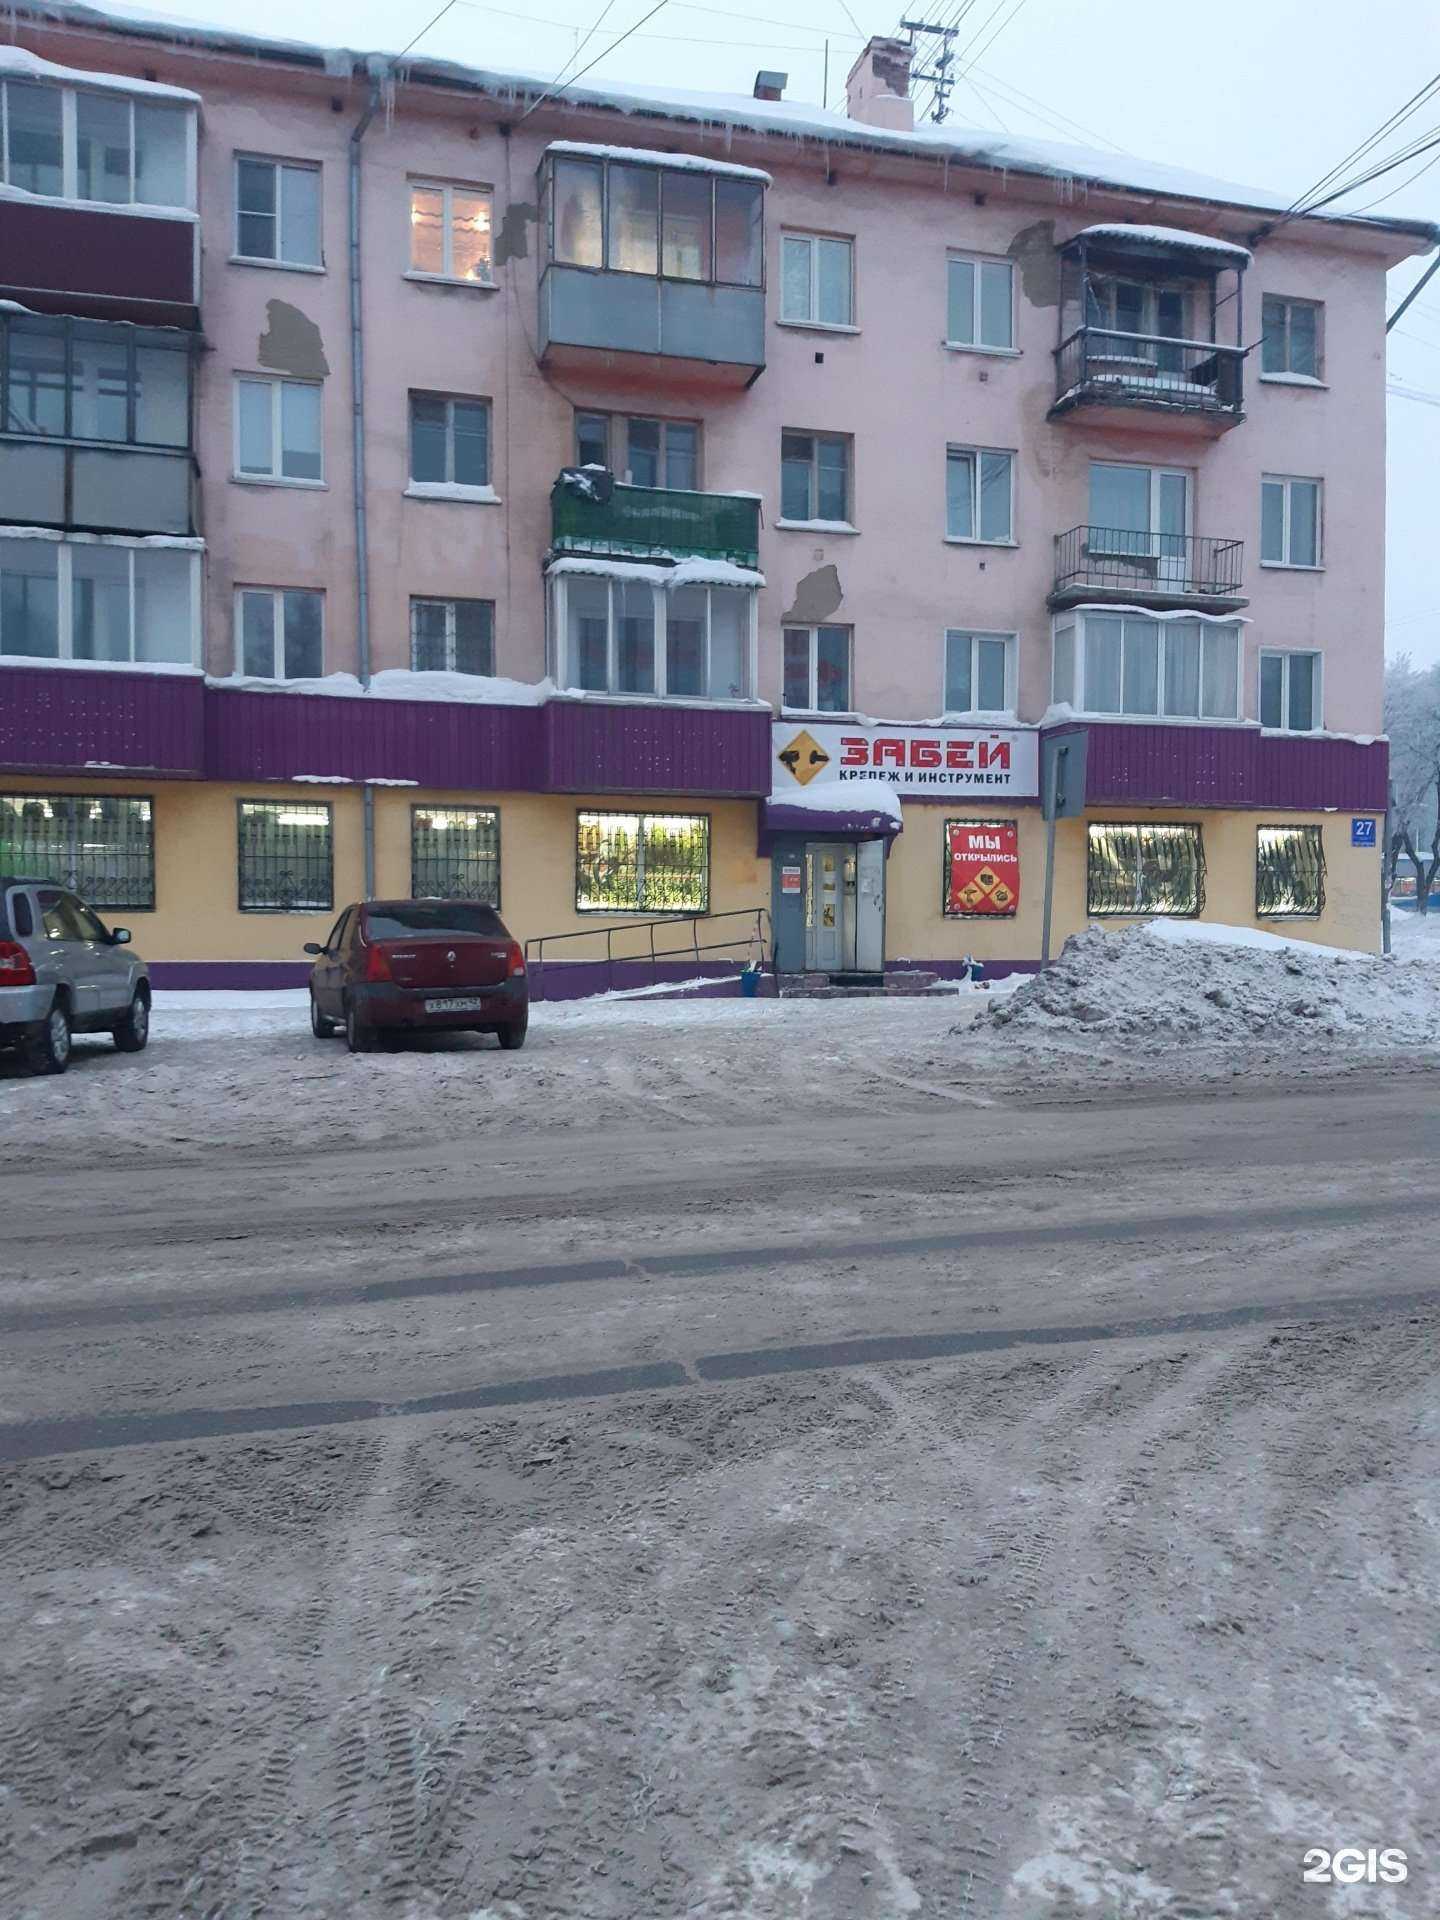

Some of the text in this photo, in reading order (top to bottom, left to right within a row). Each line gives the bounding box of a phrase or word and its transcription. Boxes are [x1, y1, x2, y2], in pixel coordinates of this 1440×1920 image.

[840, 734, 1011, 769] ЗАБЕЙ
[839, 770, 1011, 785] КРЕПЕЖ И ИНСТРУМЕНТ
[1356, 821, 1373, 836] 27
[968, 835, 1001, 849] МЫ
[954, 852, 1018, 863] ОТКРЫЛИСЬ
